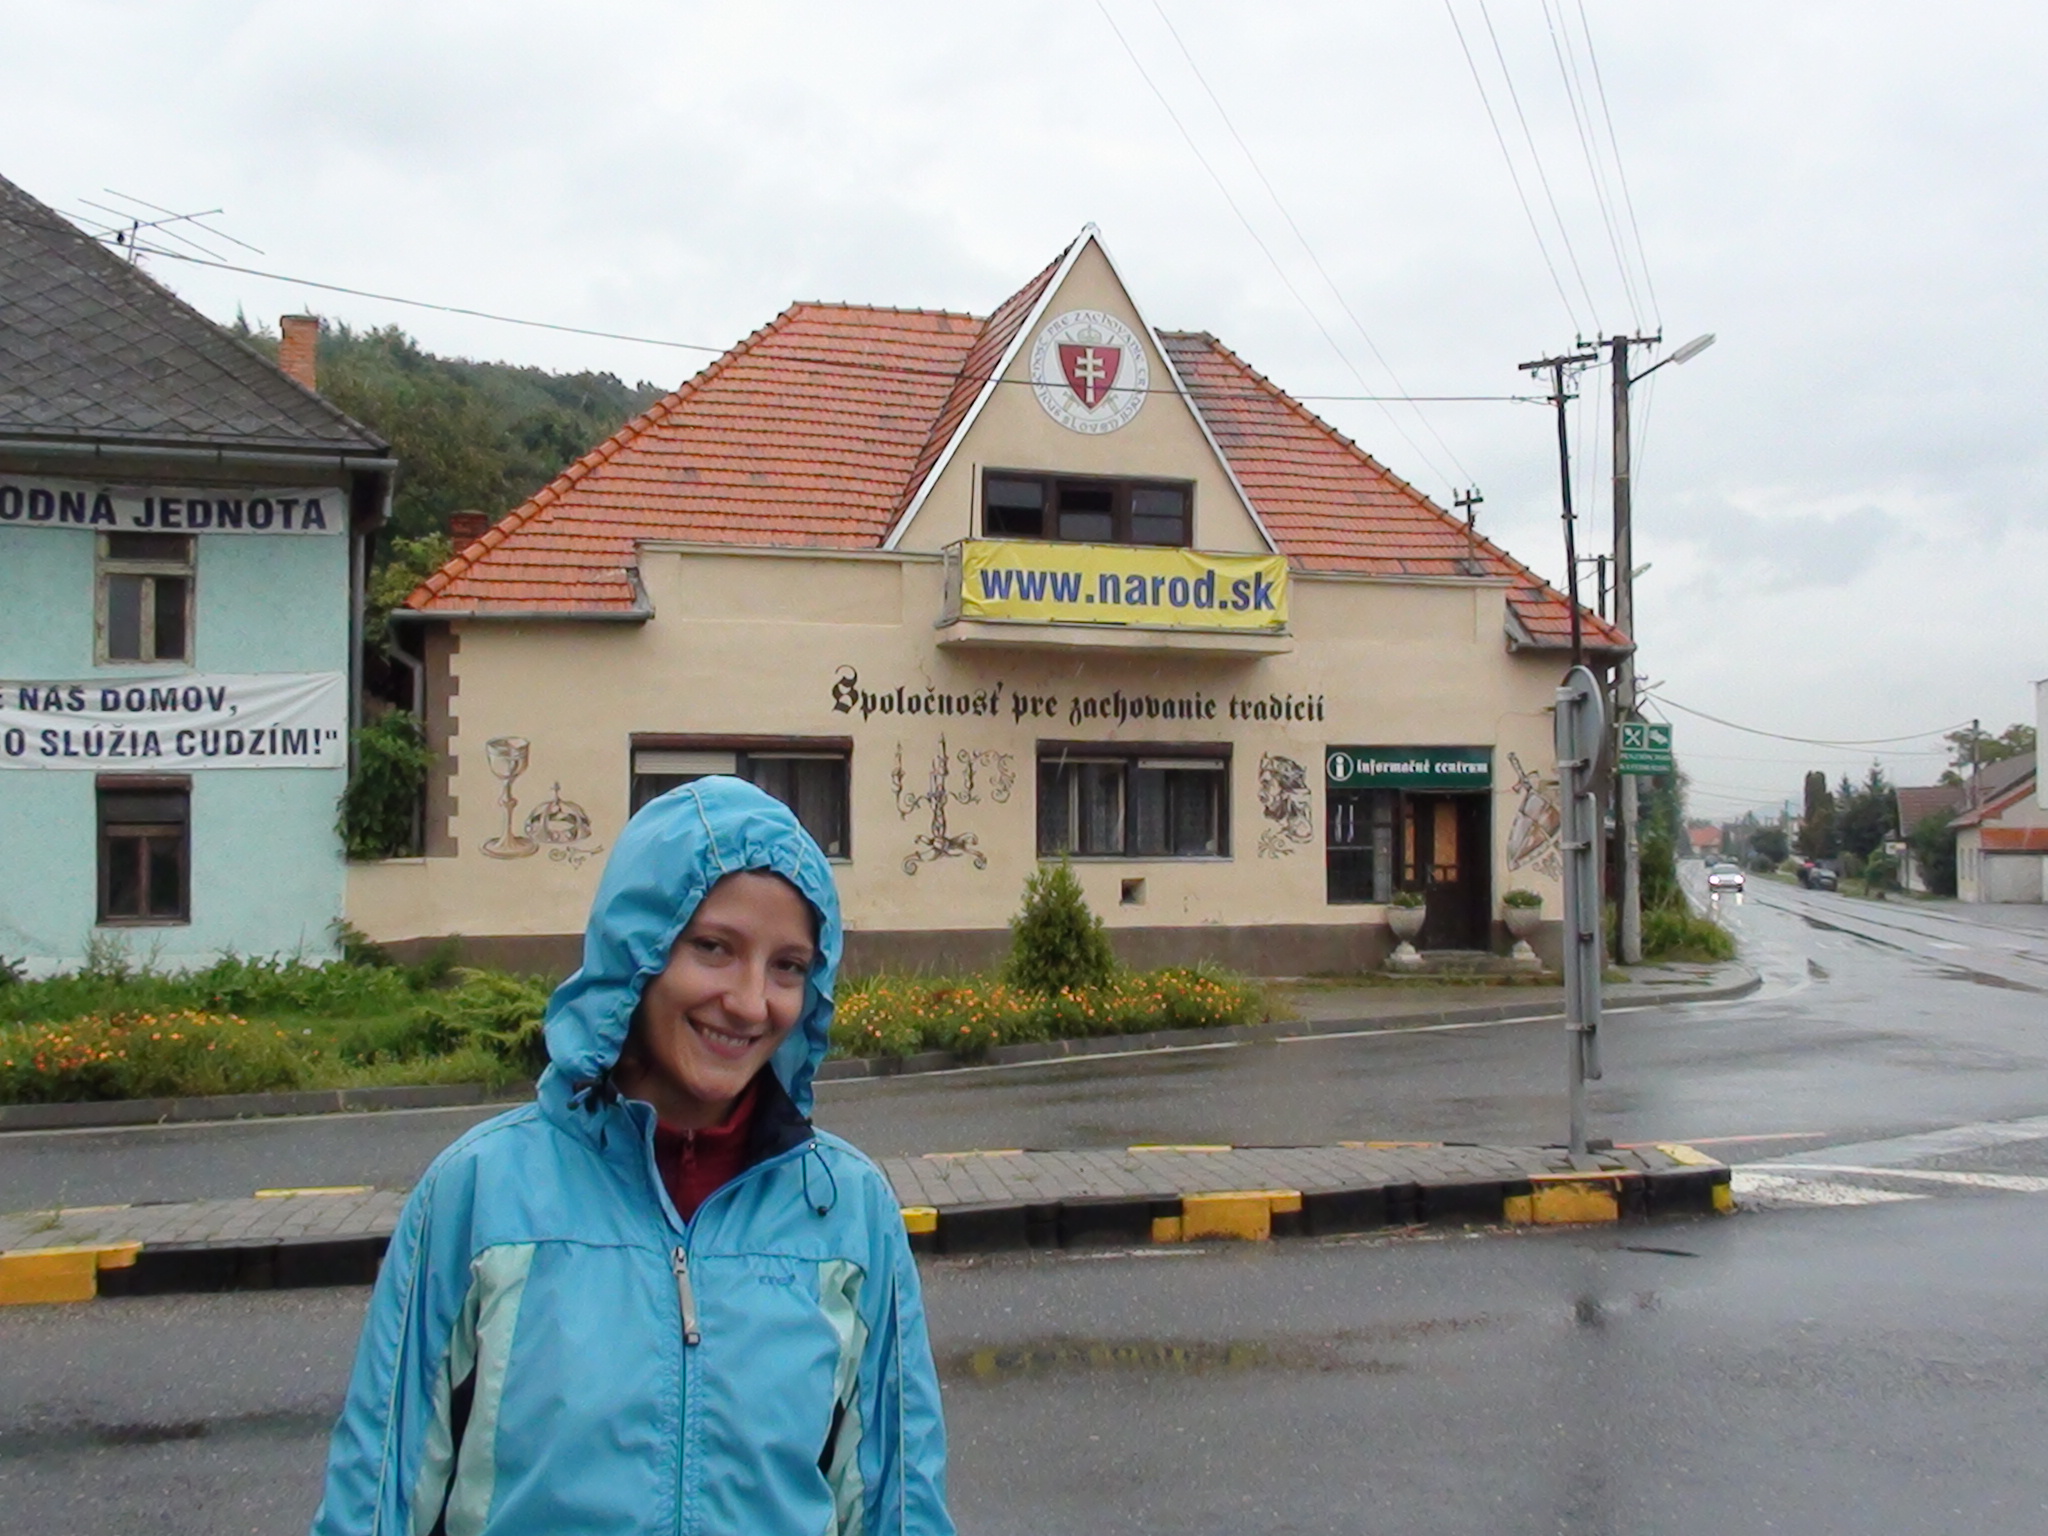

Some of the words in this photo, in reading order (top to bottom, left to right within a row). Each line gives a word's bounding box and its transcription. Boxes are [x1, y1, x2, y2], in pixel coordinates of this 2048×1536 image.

[133, 497, 326, 530] JEDNOTA
[979, 568, 1277, 612] www.narod.sk
[19, 685, 86, 712] NÁŠ
[101, 686, 238, 716] DOMOV,
[831, 664, 1004, 723] Spoločnosť
[1011, 690, 1058, 725] pre
[1068, 689, 1217, 728] zachovanie
[40, 723, 162, 757] SLÚŽIA
[175, 722, 338, 757] CUDZÍM!"
[1434, 761, 1488, 774] centrum
